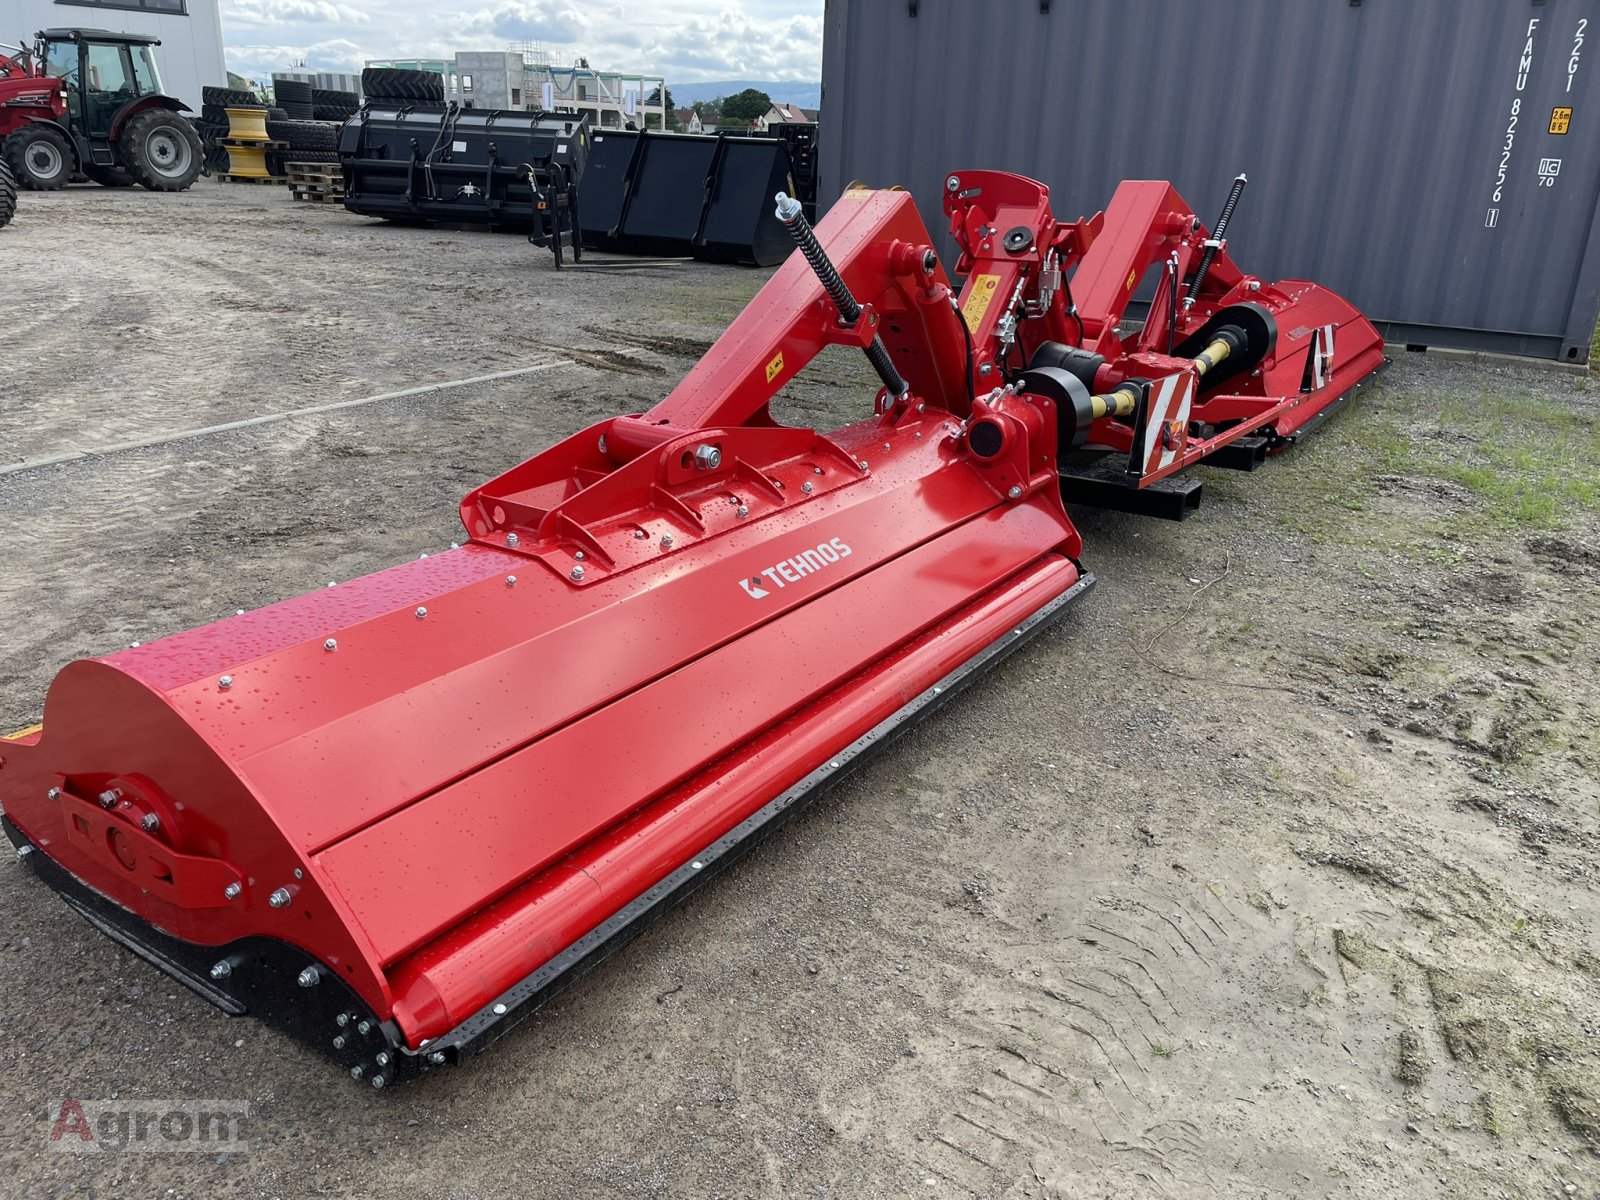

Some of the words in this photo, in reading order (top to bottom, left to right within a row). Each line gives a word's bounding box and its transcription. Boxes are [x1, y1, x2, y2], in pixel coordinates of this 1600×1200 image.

[1515, 18, 1540, 91] FAMU
[1566, 18, 1588, 92] 22G1
[1492, 98, 1522, 203] 823256
[1538, 176, 1555, 187] 70
[760, 536, 853, 589] TEHNOS
